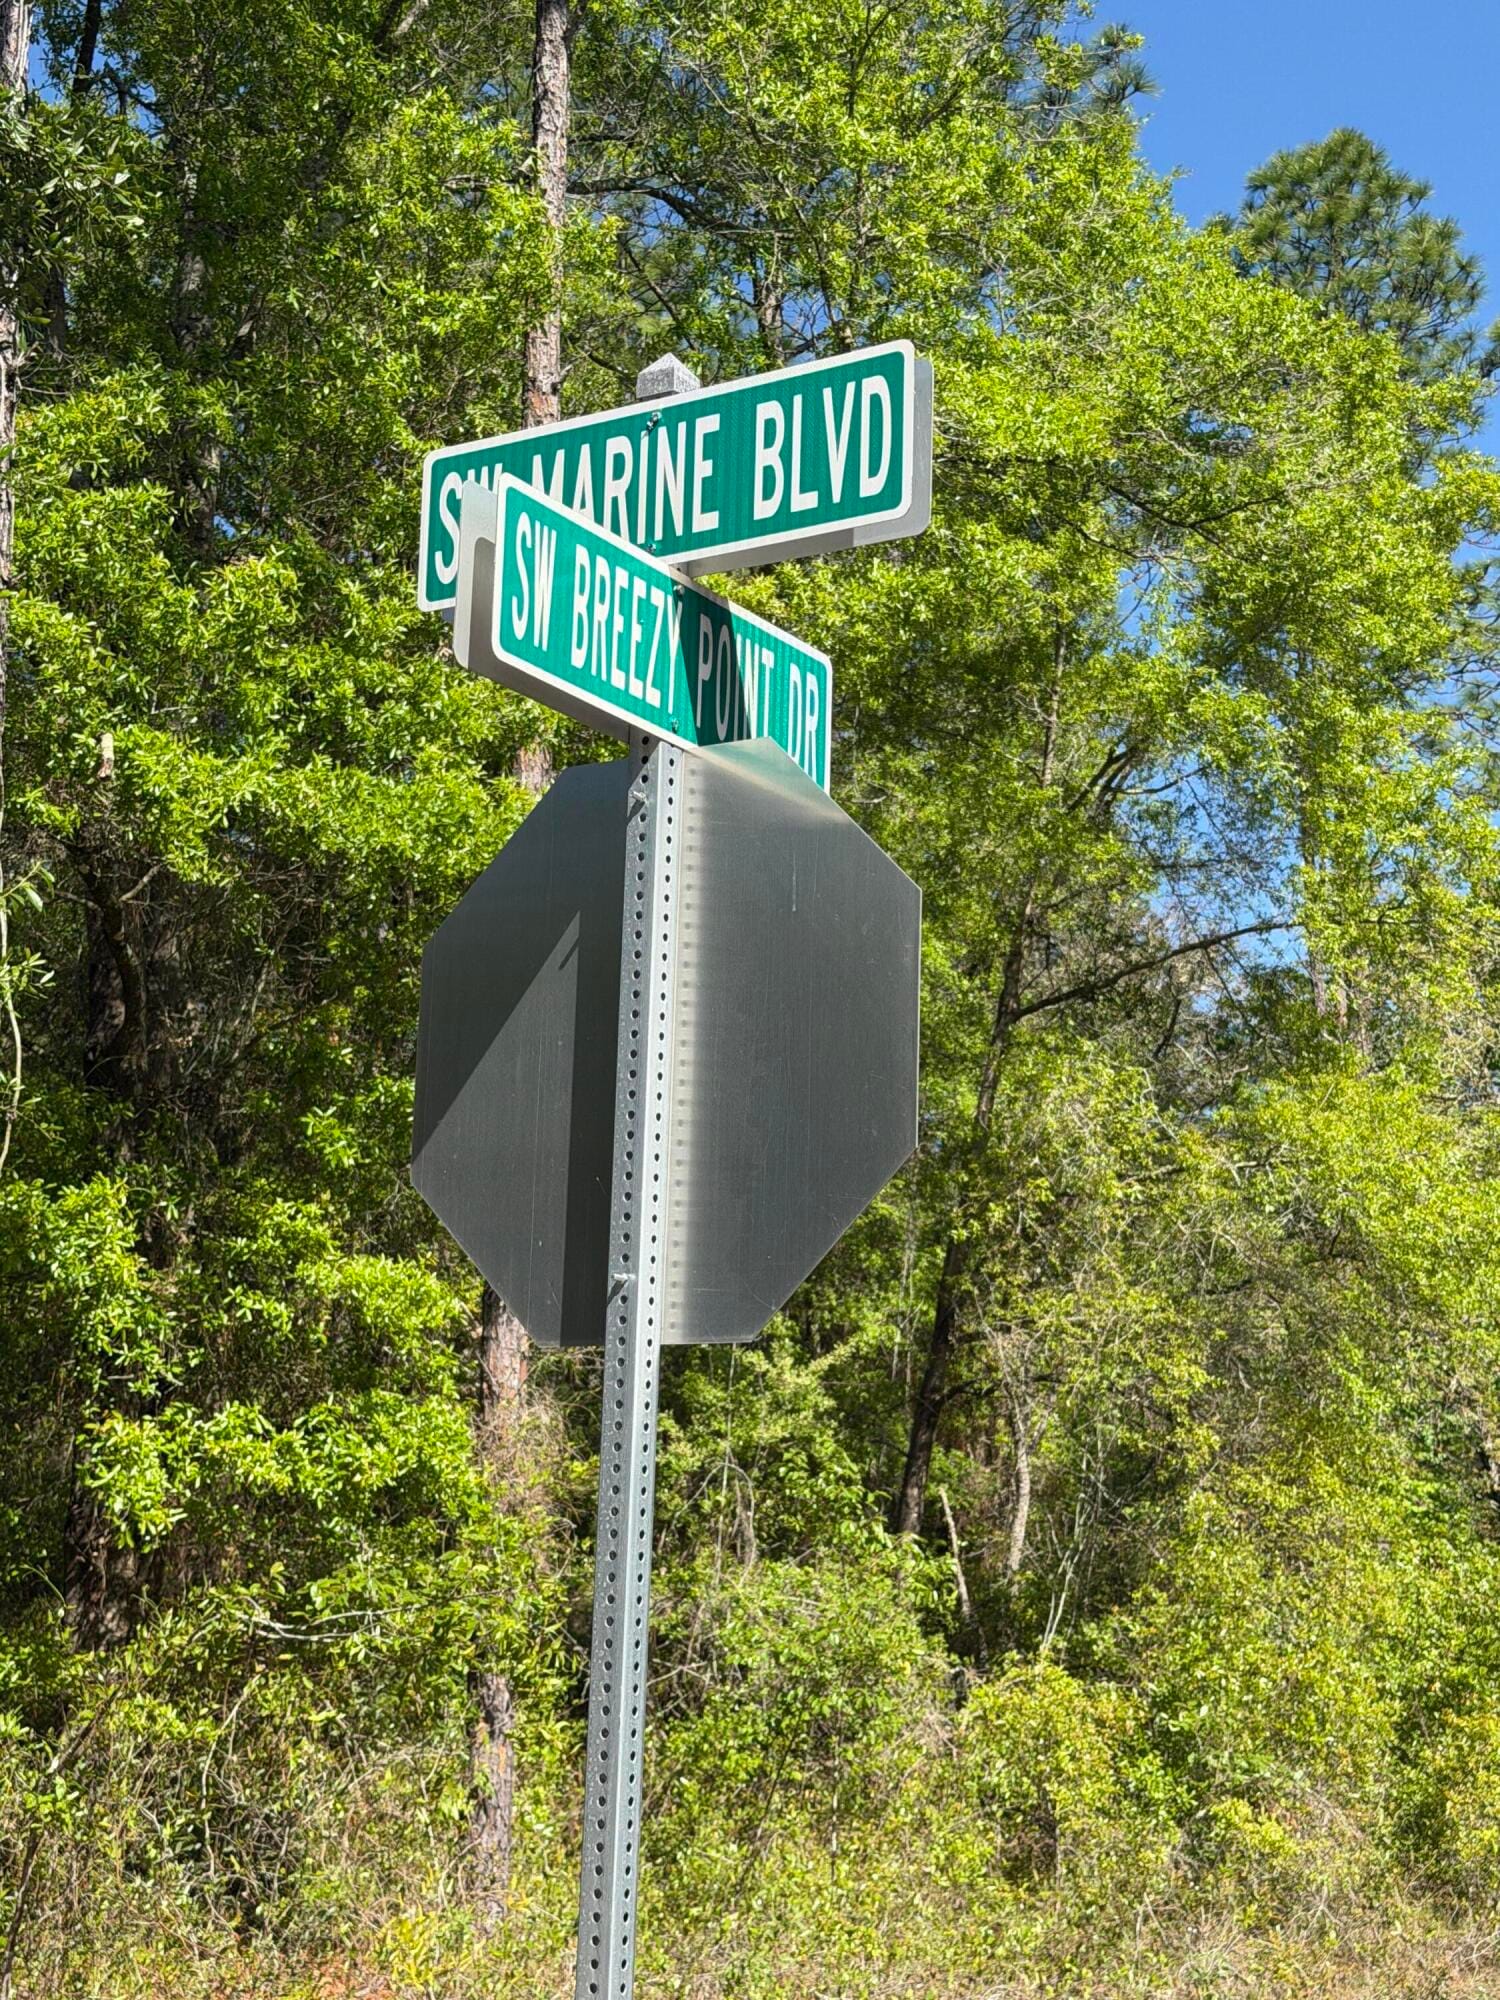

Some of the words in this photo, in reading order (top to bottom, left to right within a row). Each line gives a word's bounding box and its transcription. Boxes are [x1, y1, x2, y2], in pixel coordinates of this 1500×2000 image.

[434, 463, 503, 585] S
[753, 374, 892, 521] BLVD
[511, 511, 557, 652] SW
[570, 543, 683, 715] BREEZY
[696, 613, 775, 742] POINT
[787, 662, 819, 786] DR
